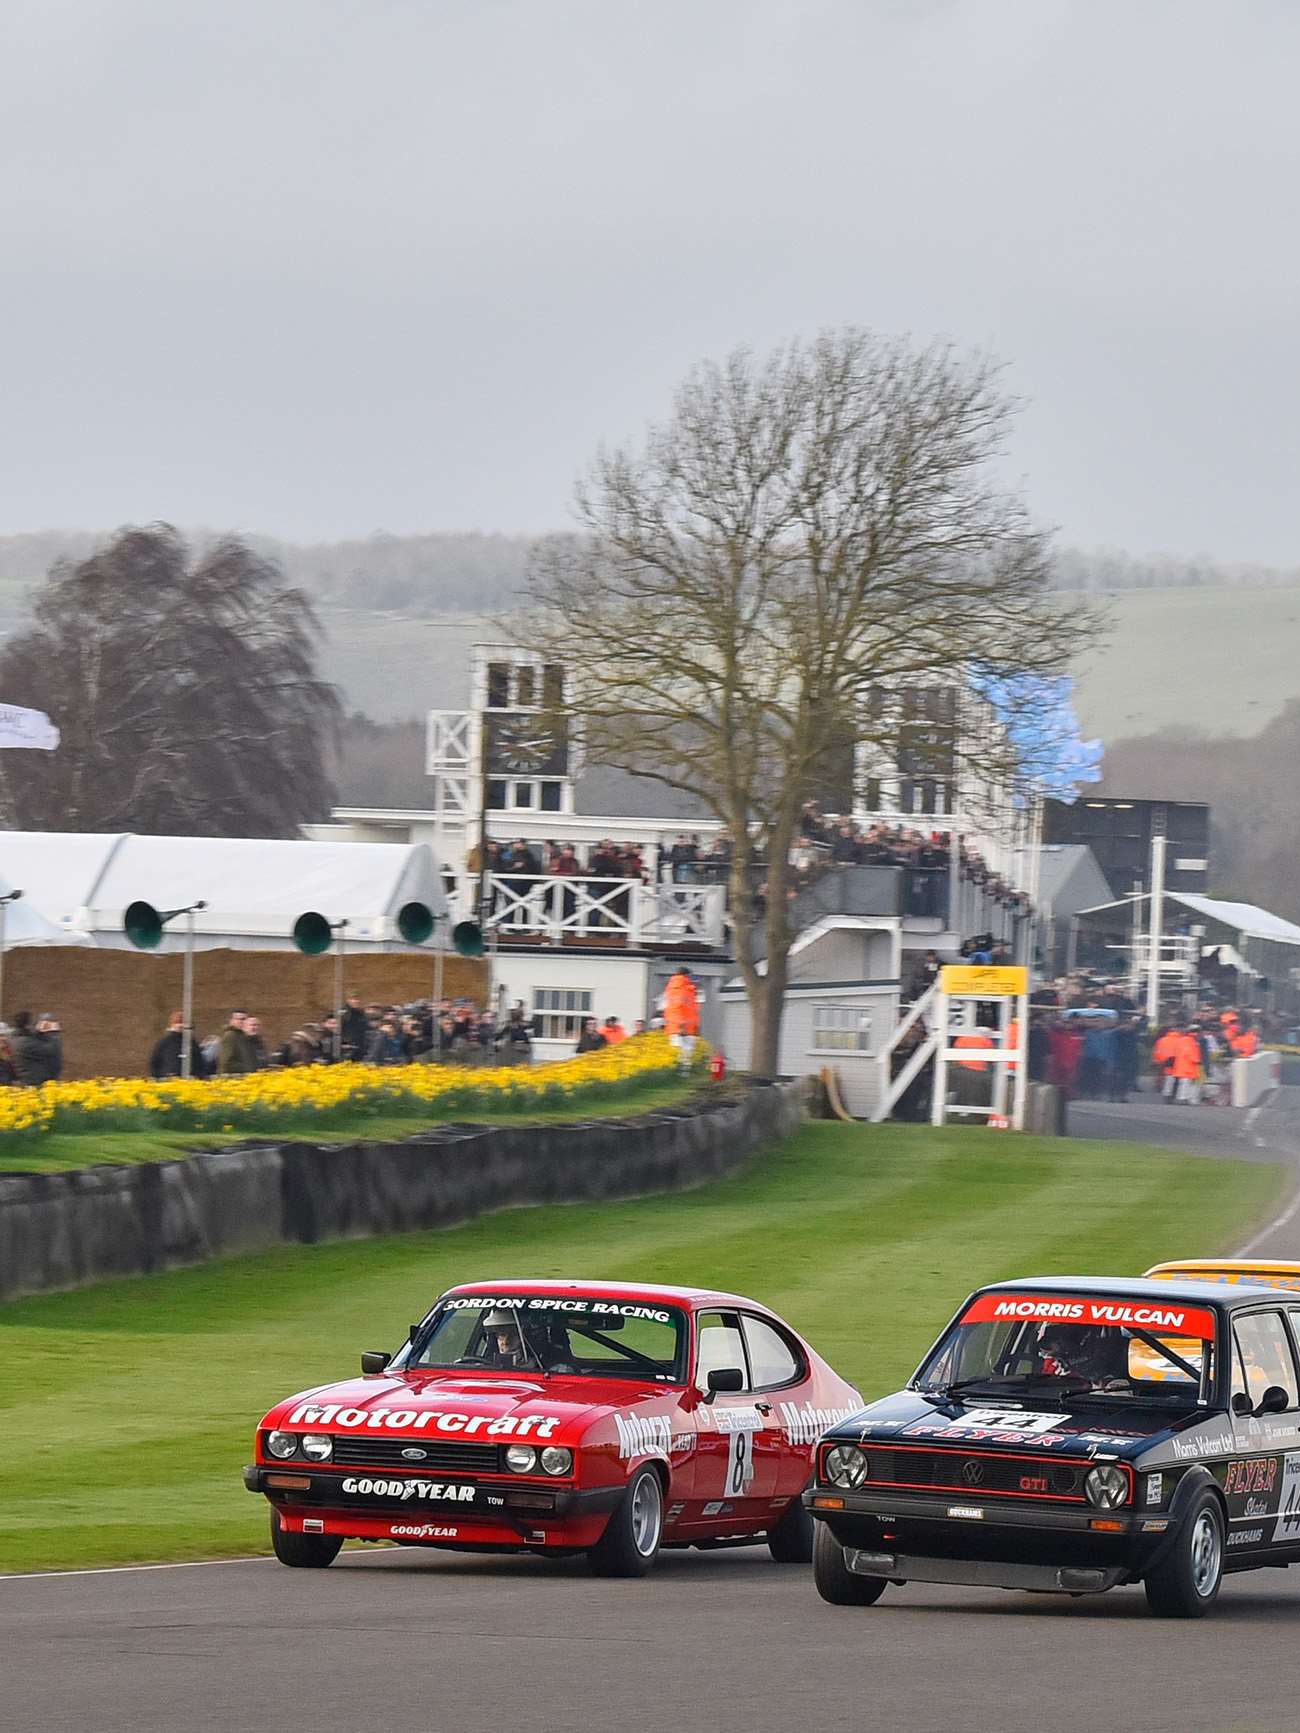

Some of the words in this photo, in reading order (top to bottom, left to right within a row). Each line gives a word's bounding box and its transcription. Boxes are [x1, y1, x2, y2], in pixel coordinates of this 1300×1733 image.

[528, 1299, 588, 1312] SPICE
[592, 1302, 670, 1323] RACING
[994, 1302, 1084, 1318] MORRIS
[1091, 1305, 1185, 1327] VULCAN
[289, 1404, 560, 1438] Motorcraft
[972, 1415, 1037, 1429] 44
[614, 1411, 673, 1460] Autocar
[902, 1425, 1065, 1446] FLYER
[1173, 1437, 1200, 1458] Morris
[1199, 1435, 1222, 1456] Vulcan
[732, 1431, 747, 1494] 8
[1019, 1476, 1048, 1490] GTI
[1224, 1458, 1277, 1494] FLYER
[487, 1496, 504, 1506] TOW
[1227, 1528, 1263, 1546] DUCKHAMS
